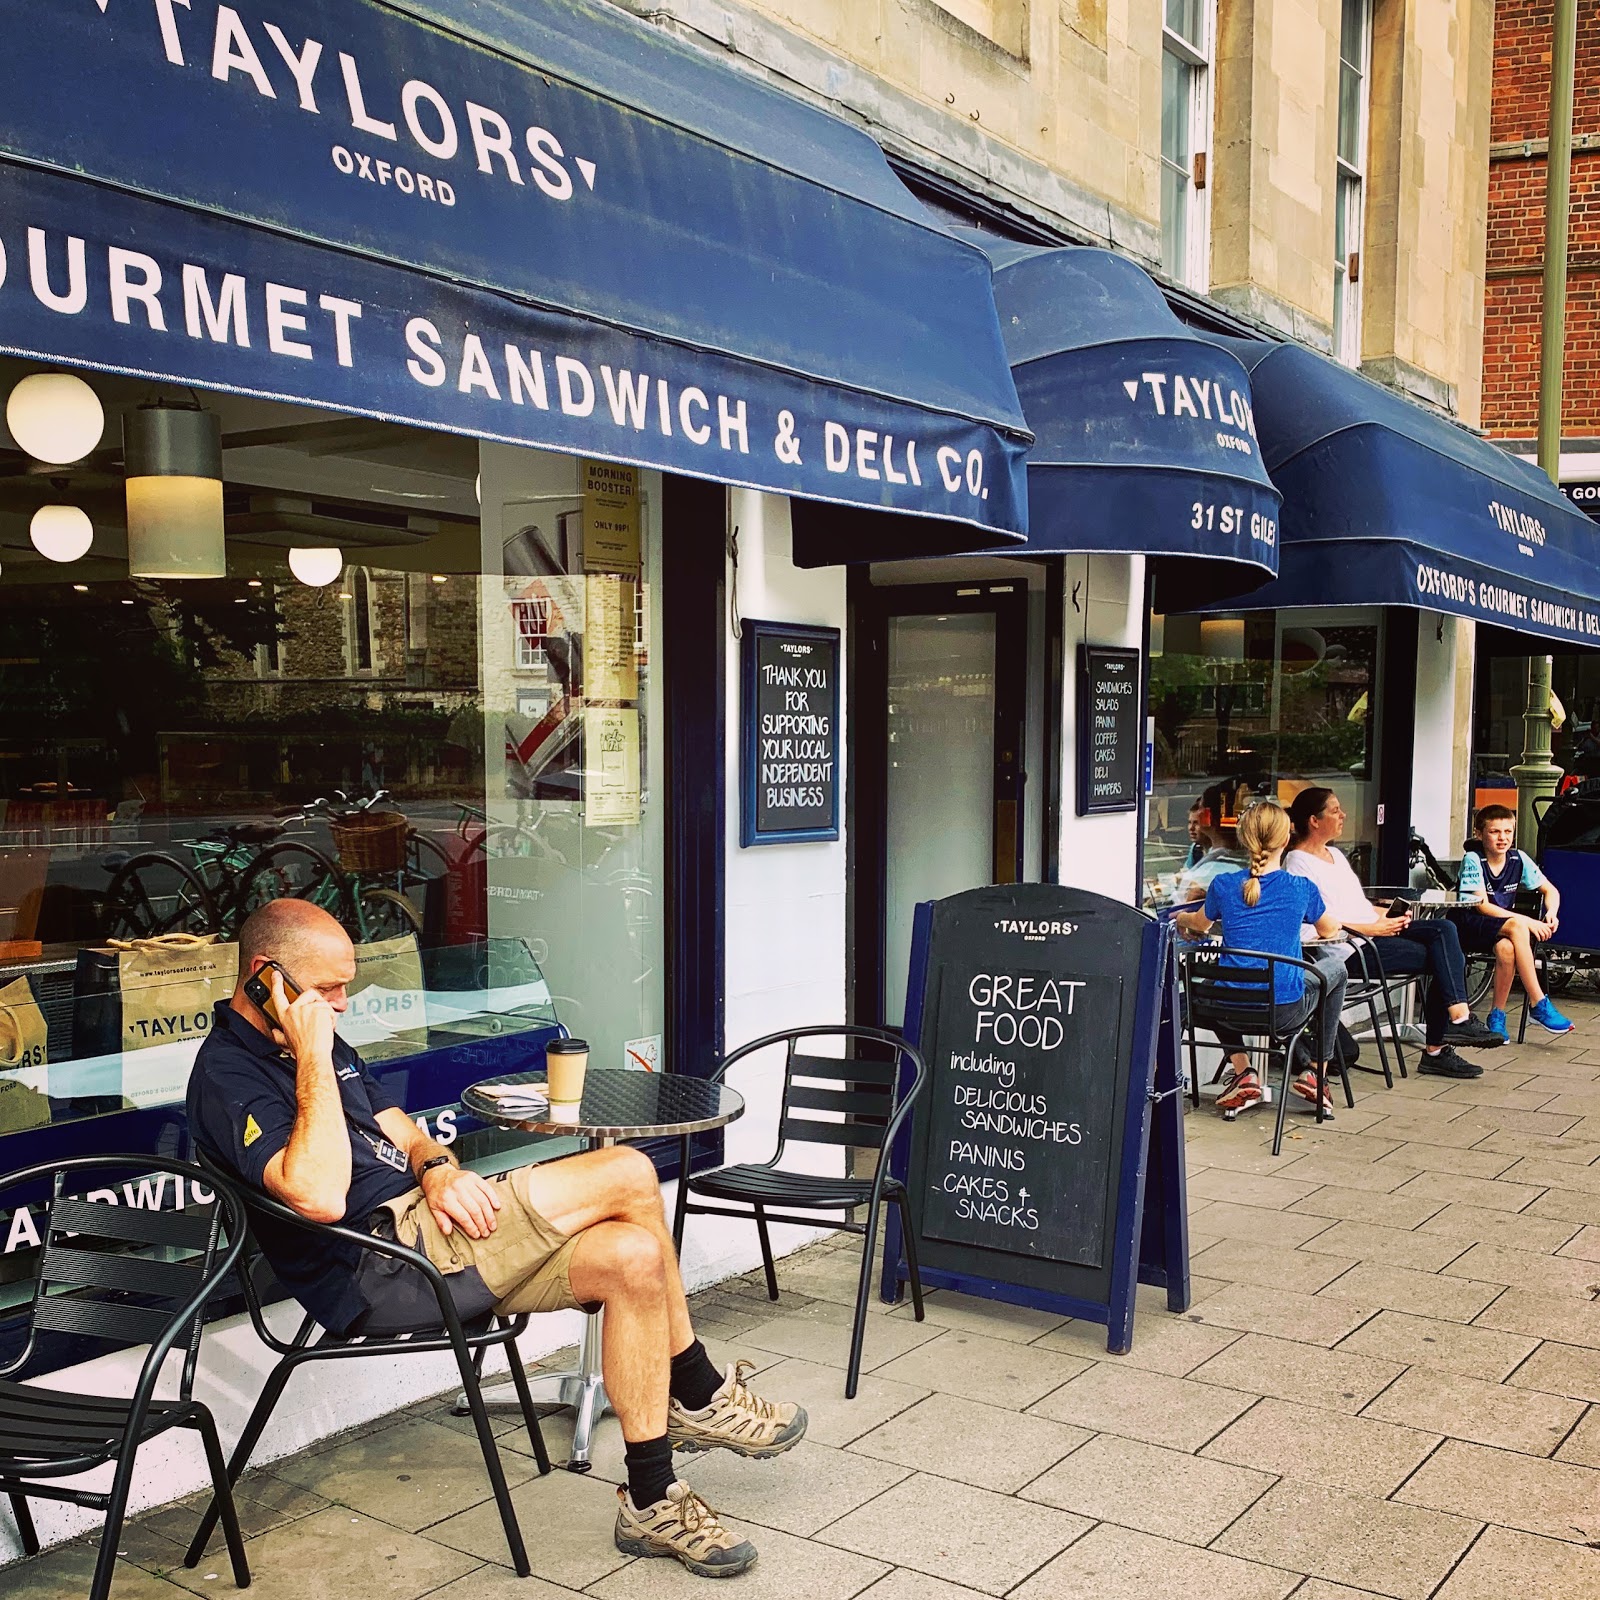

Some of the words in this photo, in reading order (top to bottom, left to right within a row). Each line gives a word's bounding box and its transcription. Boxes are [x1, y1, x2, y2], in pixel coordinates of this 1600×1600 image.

[154, 0, 573, 201] TAYLORS
[332, 145, 456, 207] OXFORD
[0, 227, 362, 368] URMET
[405, 316, 749, 454] SANDWICH
[773, 409, 803, 465] &
[825, 421, 922, 487] DELI
[938, 446, 989, 499] CO.
[1217, 432, 1252, 455] OXFORD
[589, 466, 632, 483] MORNING
[587, 480, 635, 496] BOOSTER!
[594, 520, 612, 532] ONLY
[1191, 502, 1214, 531] 31
[1219, 505, 1244, 535] ST
[1491, 500, 1544, 547] TAYLORS
[1416, 563, 1476, 606] OXFORD'S
[1479, 582, 1528, 620] GOURMET
[1531, 598, 1576, 632] SANDWICH
[1578, 610, 1585, 633] &
[783, 643, 811, 655] TAYLORS
[762, 664, 803, 687] THANK
[803, 667, 827, 689] YOU
[1095, 681, 1133, 695] SANDWICHES
[785, 690, 809, 712] FOR
[1095, 698, 1119, 712] SALADS
[761, 714, 829, 736] SUPPORTING
[762, 739, 794, 760] YOUR
[795, 739, 831, 760] LOCAL
[1094, 732, 1118, 746] COFFEE
[1094, 749, 1116, 763] CAKES
[762, 762, 833, 784] INDEPENDENT
[1094, 766, 1109, 780] DELI
[766, 786, 824, 809] BUSINESS
[1094, 782, 1122, 796] HAMPERS
[1000, 920, 1072, 936] TAYLORS
[969, 973, 1086, 1015] GREAT
[136, 1010, 216, 1038] TAYLO
[975, 1010, 1064, 1050] FOOD
[950, 1051, 1016, 1088] including
[954, 1085, 1047, 1115] DELICIOUS
[960, 1110, 1082, 1145] SANDWICHES
[950, 1140, 1026, 1171] PANINIS
[943, 1173, 1009, 1202] CAKES
[955, 1199, 1040, 1230] SNACKS
